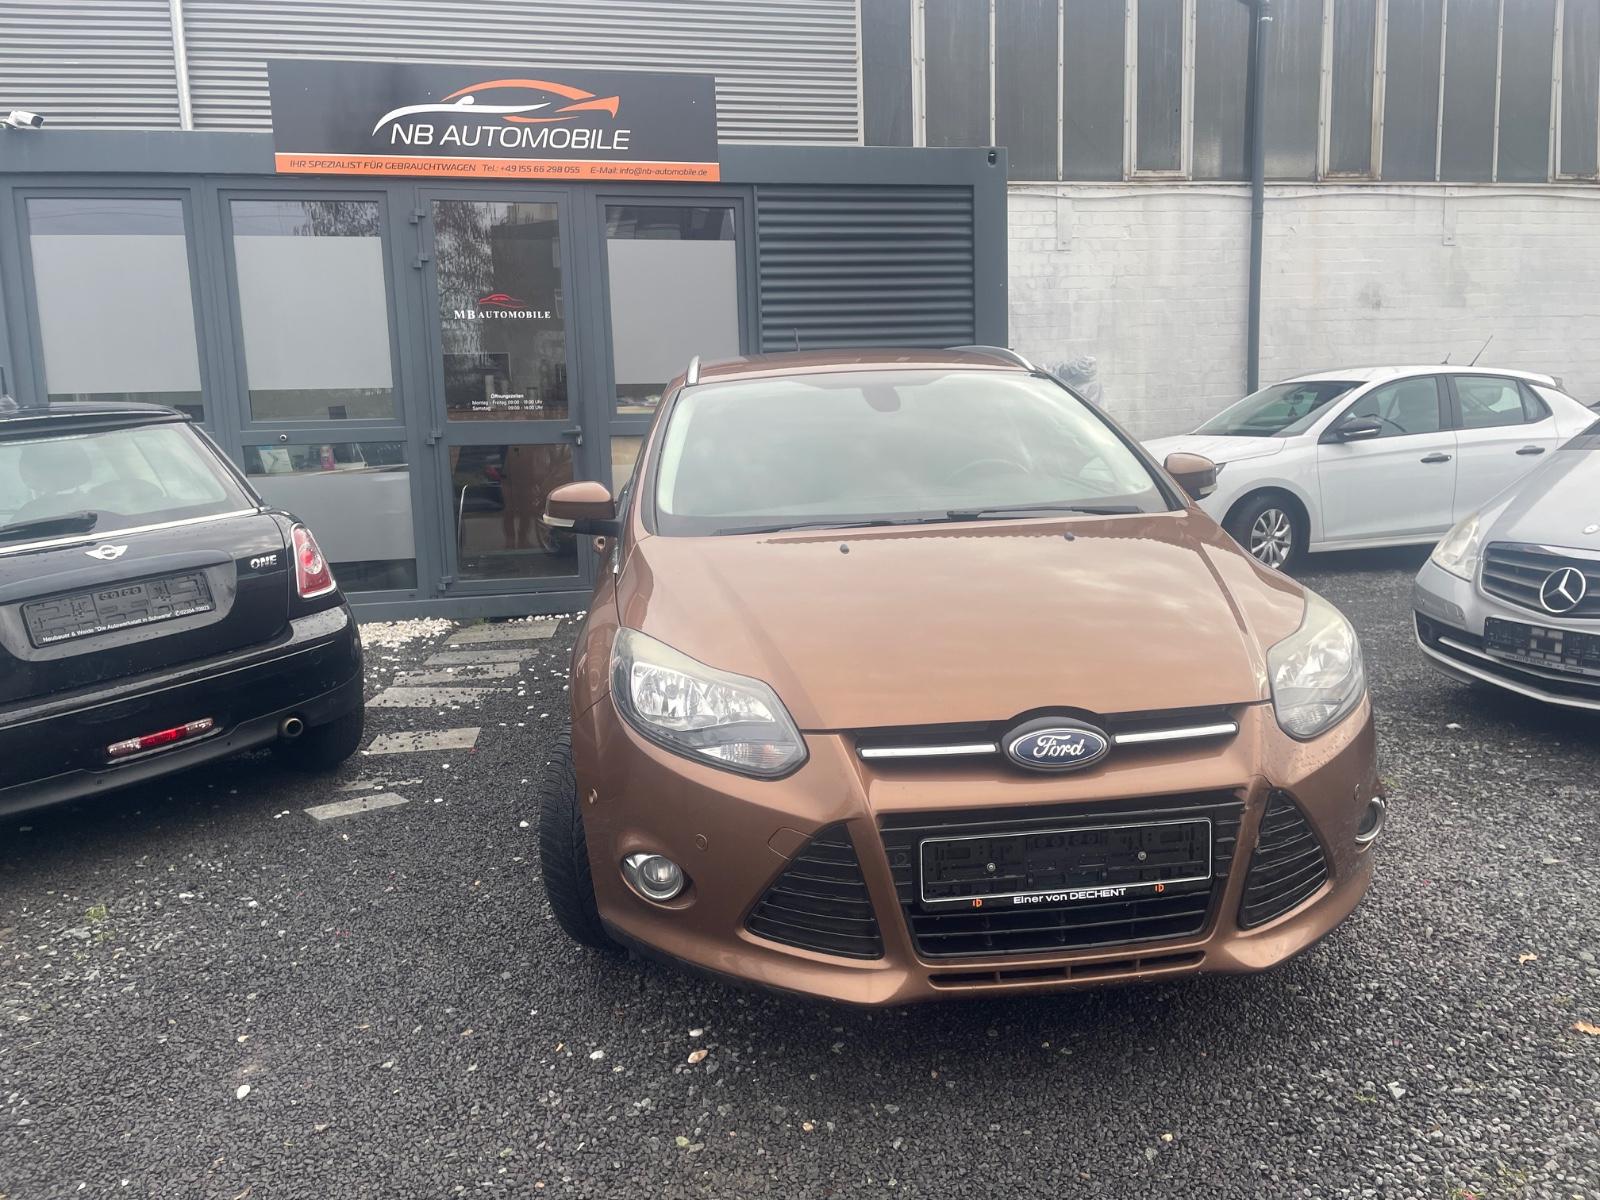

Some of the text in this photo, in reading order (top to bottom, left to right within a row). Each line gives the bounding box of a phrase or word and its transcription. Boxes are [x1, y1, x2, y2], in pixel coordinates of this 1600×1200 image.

[391, 123, 631, 150] NB AUTOMOBILE
[289, 160, 306, 168] IHR
[308, 160, 363, 169] SPEZIALIST
[363, 160, 383, 169] FÜR
[384, 161, 476, 172] GEBRAUCHTWAGEN
[500, 165, 517, 173] +49
[518, 165, 533, 173] 155
[534, 165, 545, 173] 66
[564, 166, 580, 174] 055
[590, 166, 618, 175] E-Mail:
[619, 167, 708, 177] info@nb-automobile.de
[454, 309, 551, 320] MB AUTOMOBILE
[250, 554, 277, 569] ONE
[107, 618, 141, 630] Autowerkstatt
[1033, 734, 1085, 758] Ford
[1045, 893, 1067, 902] von
[1069, 887, 1127, 901] DECHENT
